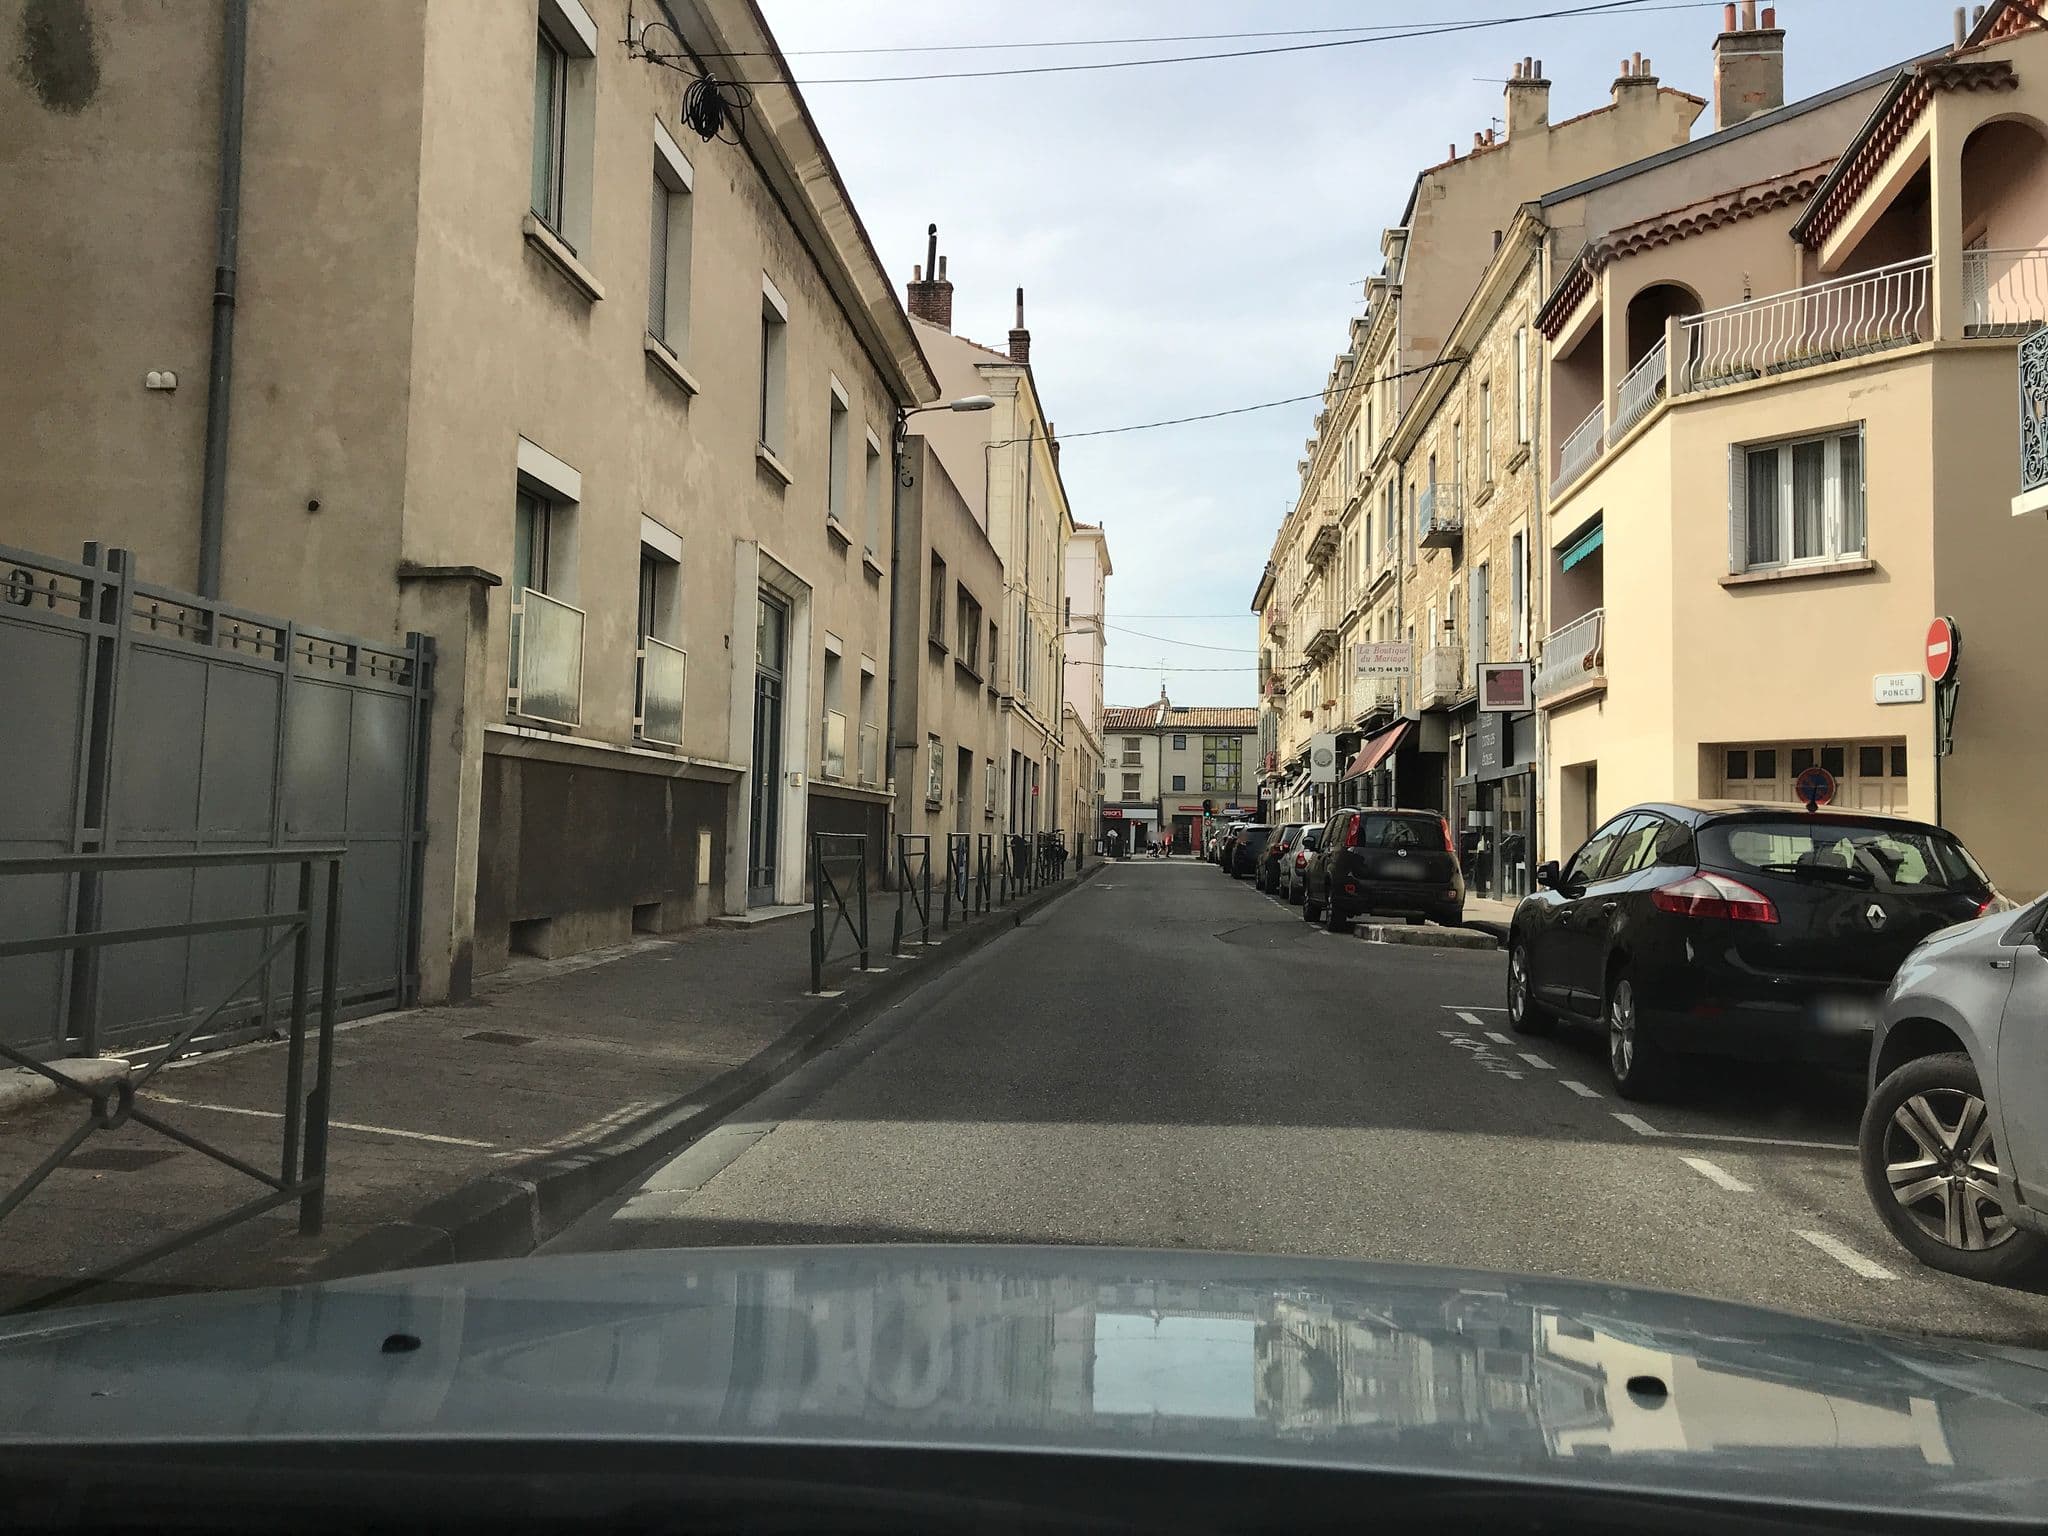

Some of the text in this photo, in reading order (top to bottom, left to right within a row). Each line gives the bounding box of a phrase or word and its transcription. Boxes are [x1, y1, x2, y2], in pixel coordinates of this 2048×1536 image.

[1359, 645, 1409, 656] La Boutique
[1360, 655, 1406, 664] du Mariage
[1882, 688, 1915, 697] PONCET
